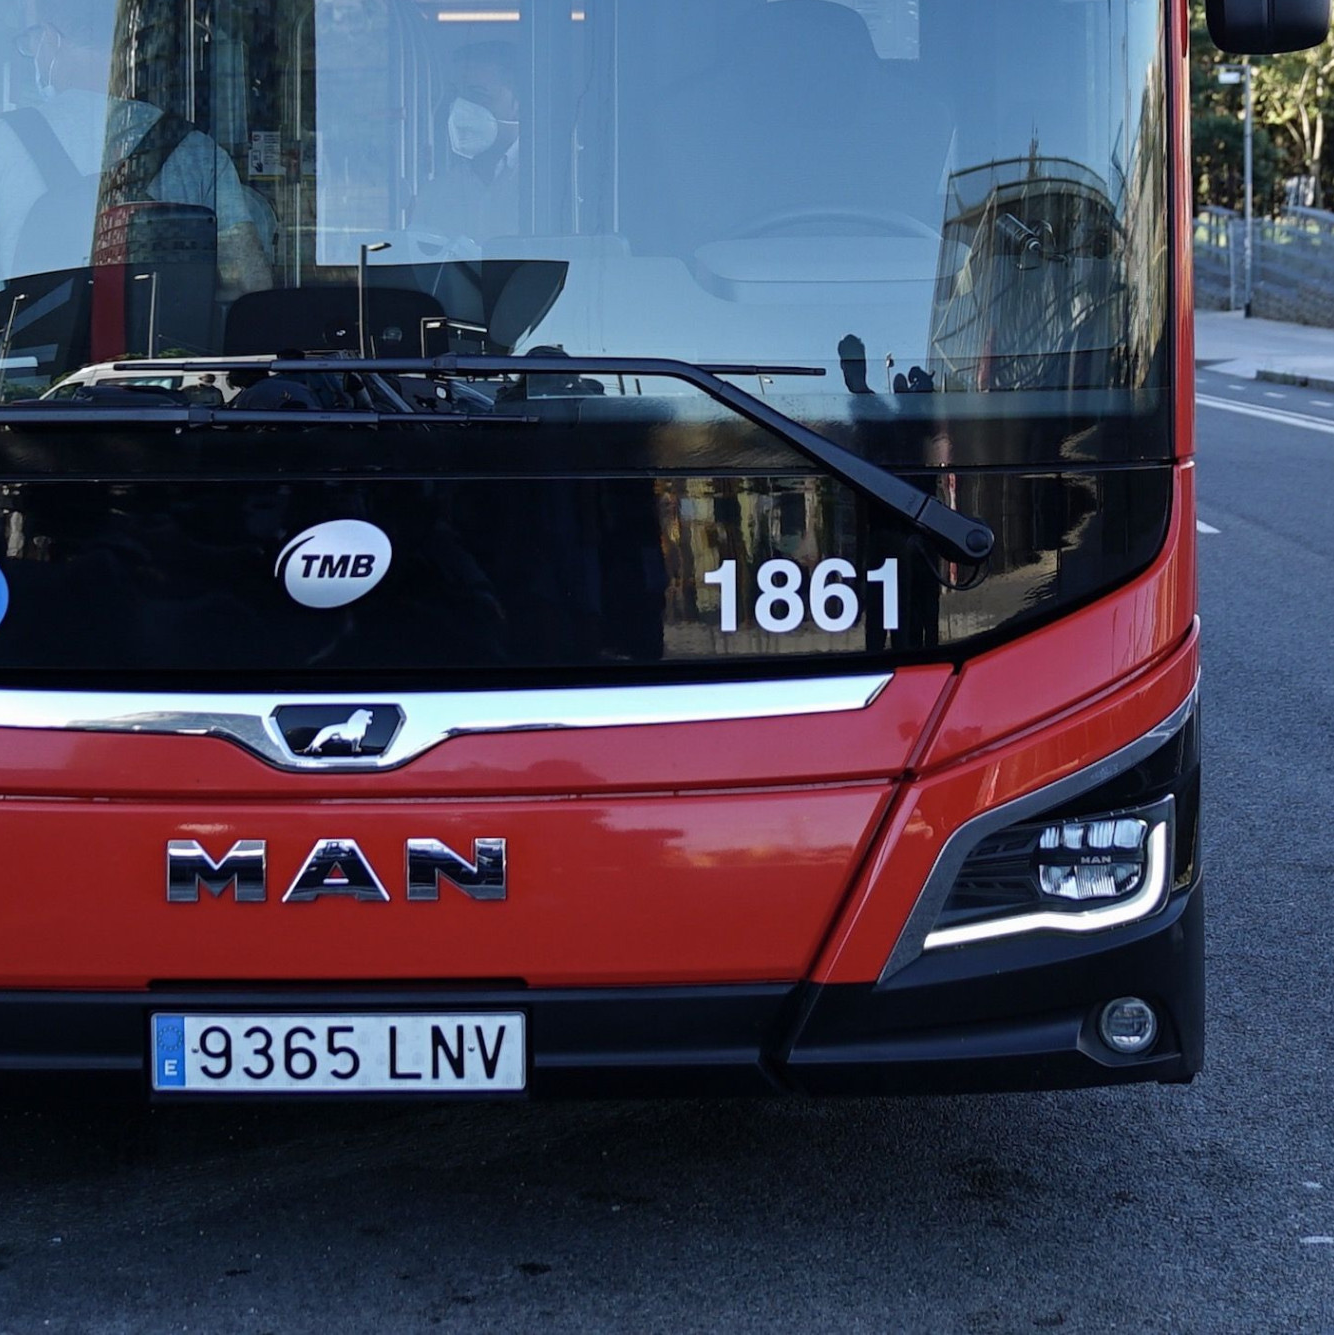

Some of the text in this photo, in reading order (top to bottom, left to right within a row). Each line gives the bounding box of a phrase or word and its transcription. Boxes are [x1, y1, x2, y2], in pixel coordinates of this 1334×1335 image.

[301, 553, 376, 579] TMB
[704, 557, 899, 633] 1861
[167, 837, 507, 903] MAN
[1080, 855, 1112, 864] MAN
[164, 1059, 178, 1076] E
[198, 1024, 507, 1080] 9365 LNV
